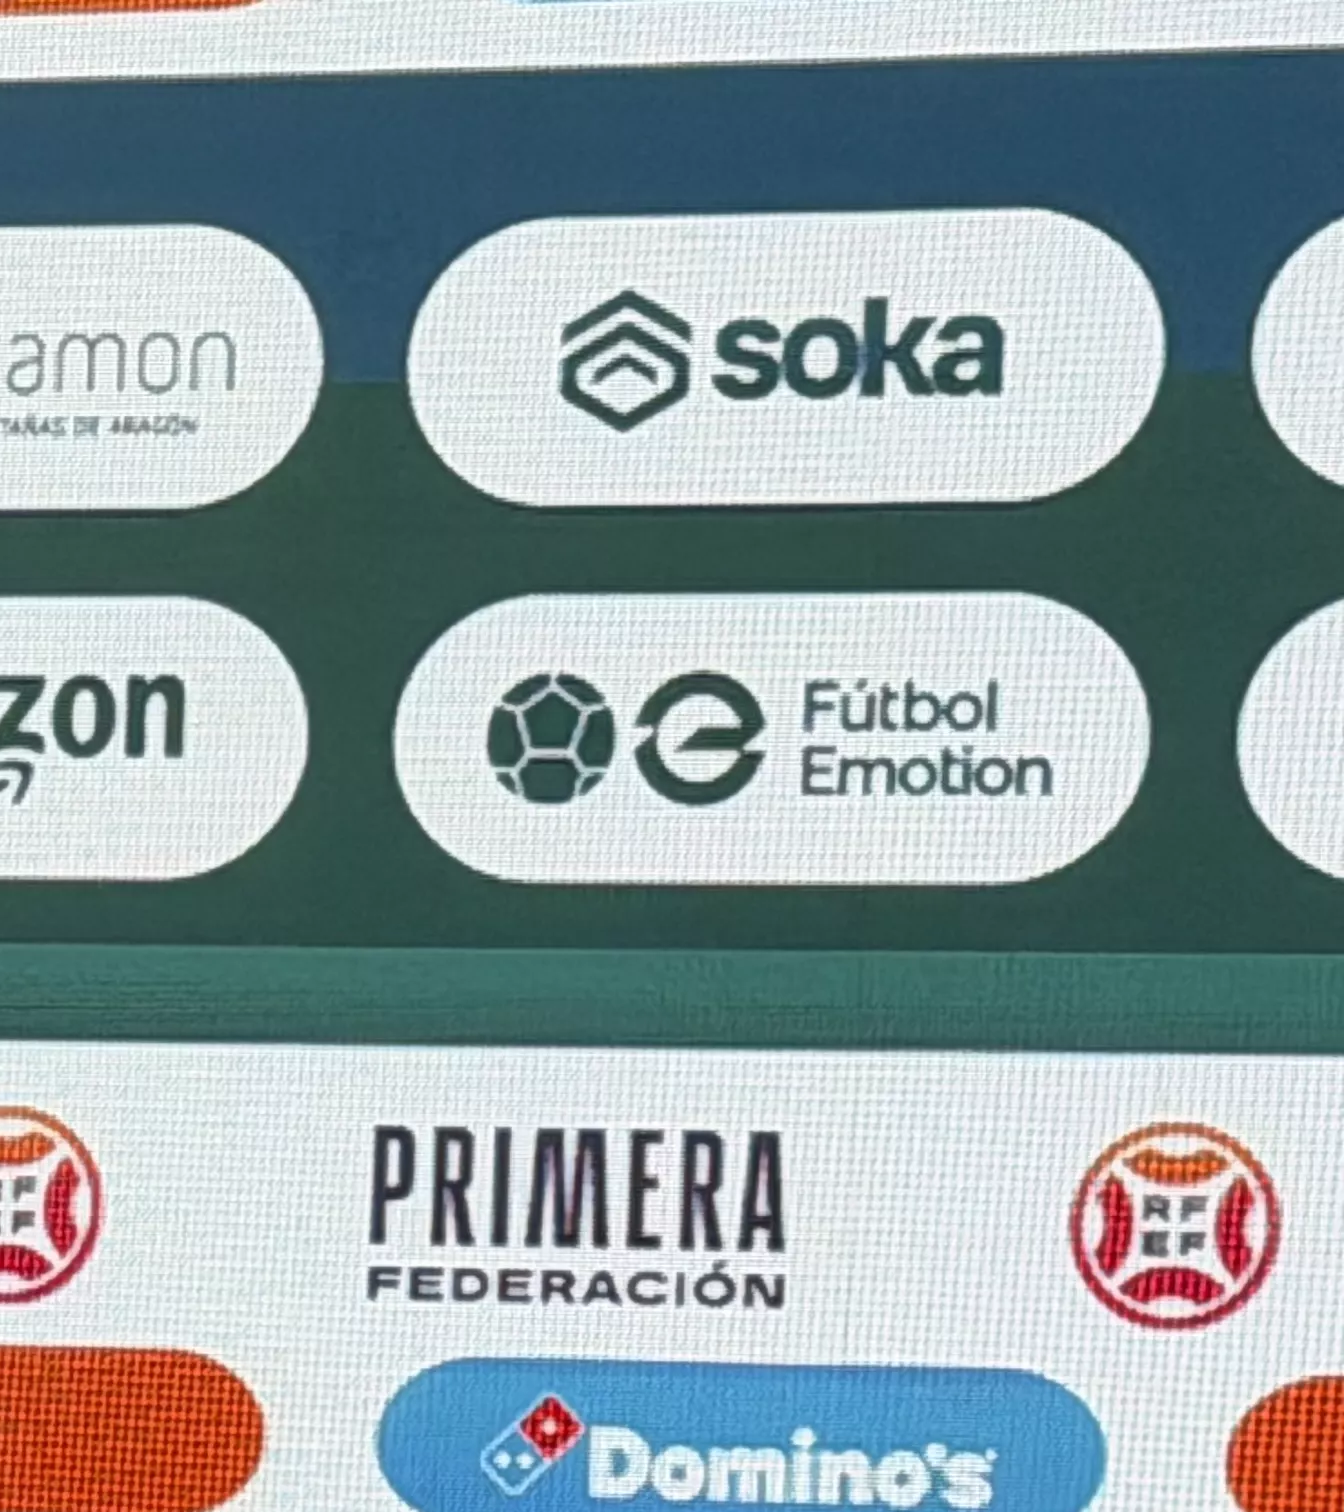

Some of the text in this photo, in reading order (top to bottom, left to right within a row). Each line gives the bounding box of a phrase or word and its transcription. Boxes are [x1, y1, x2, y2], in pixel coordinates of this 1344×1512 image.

[712, 297, 1004, 400] soka
[803, 678, 998, 732] Fútbol
[801, 745, 1053, 796] Emotion
[370, 1125, 785, 1252] PRIMERA
[367, 1260, 785, 1309] FEDERACIÓN
[589, 1426, 997, 1508] Domino's
